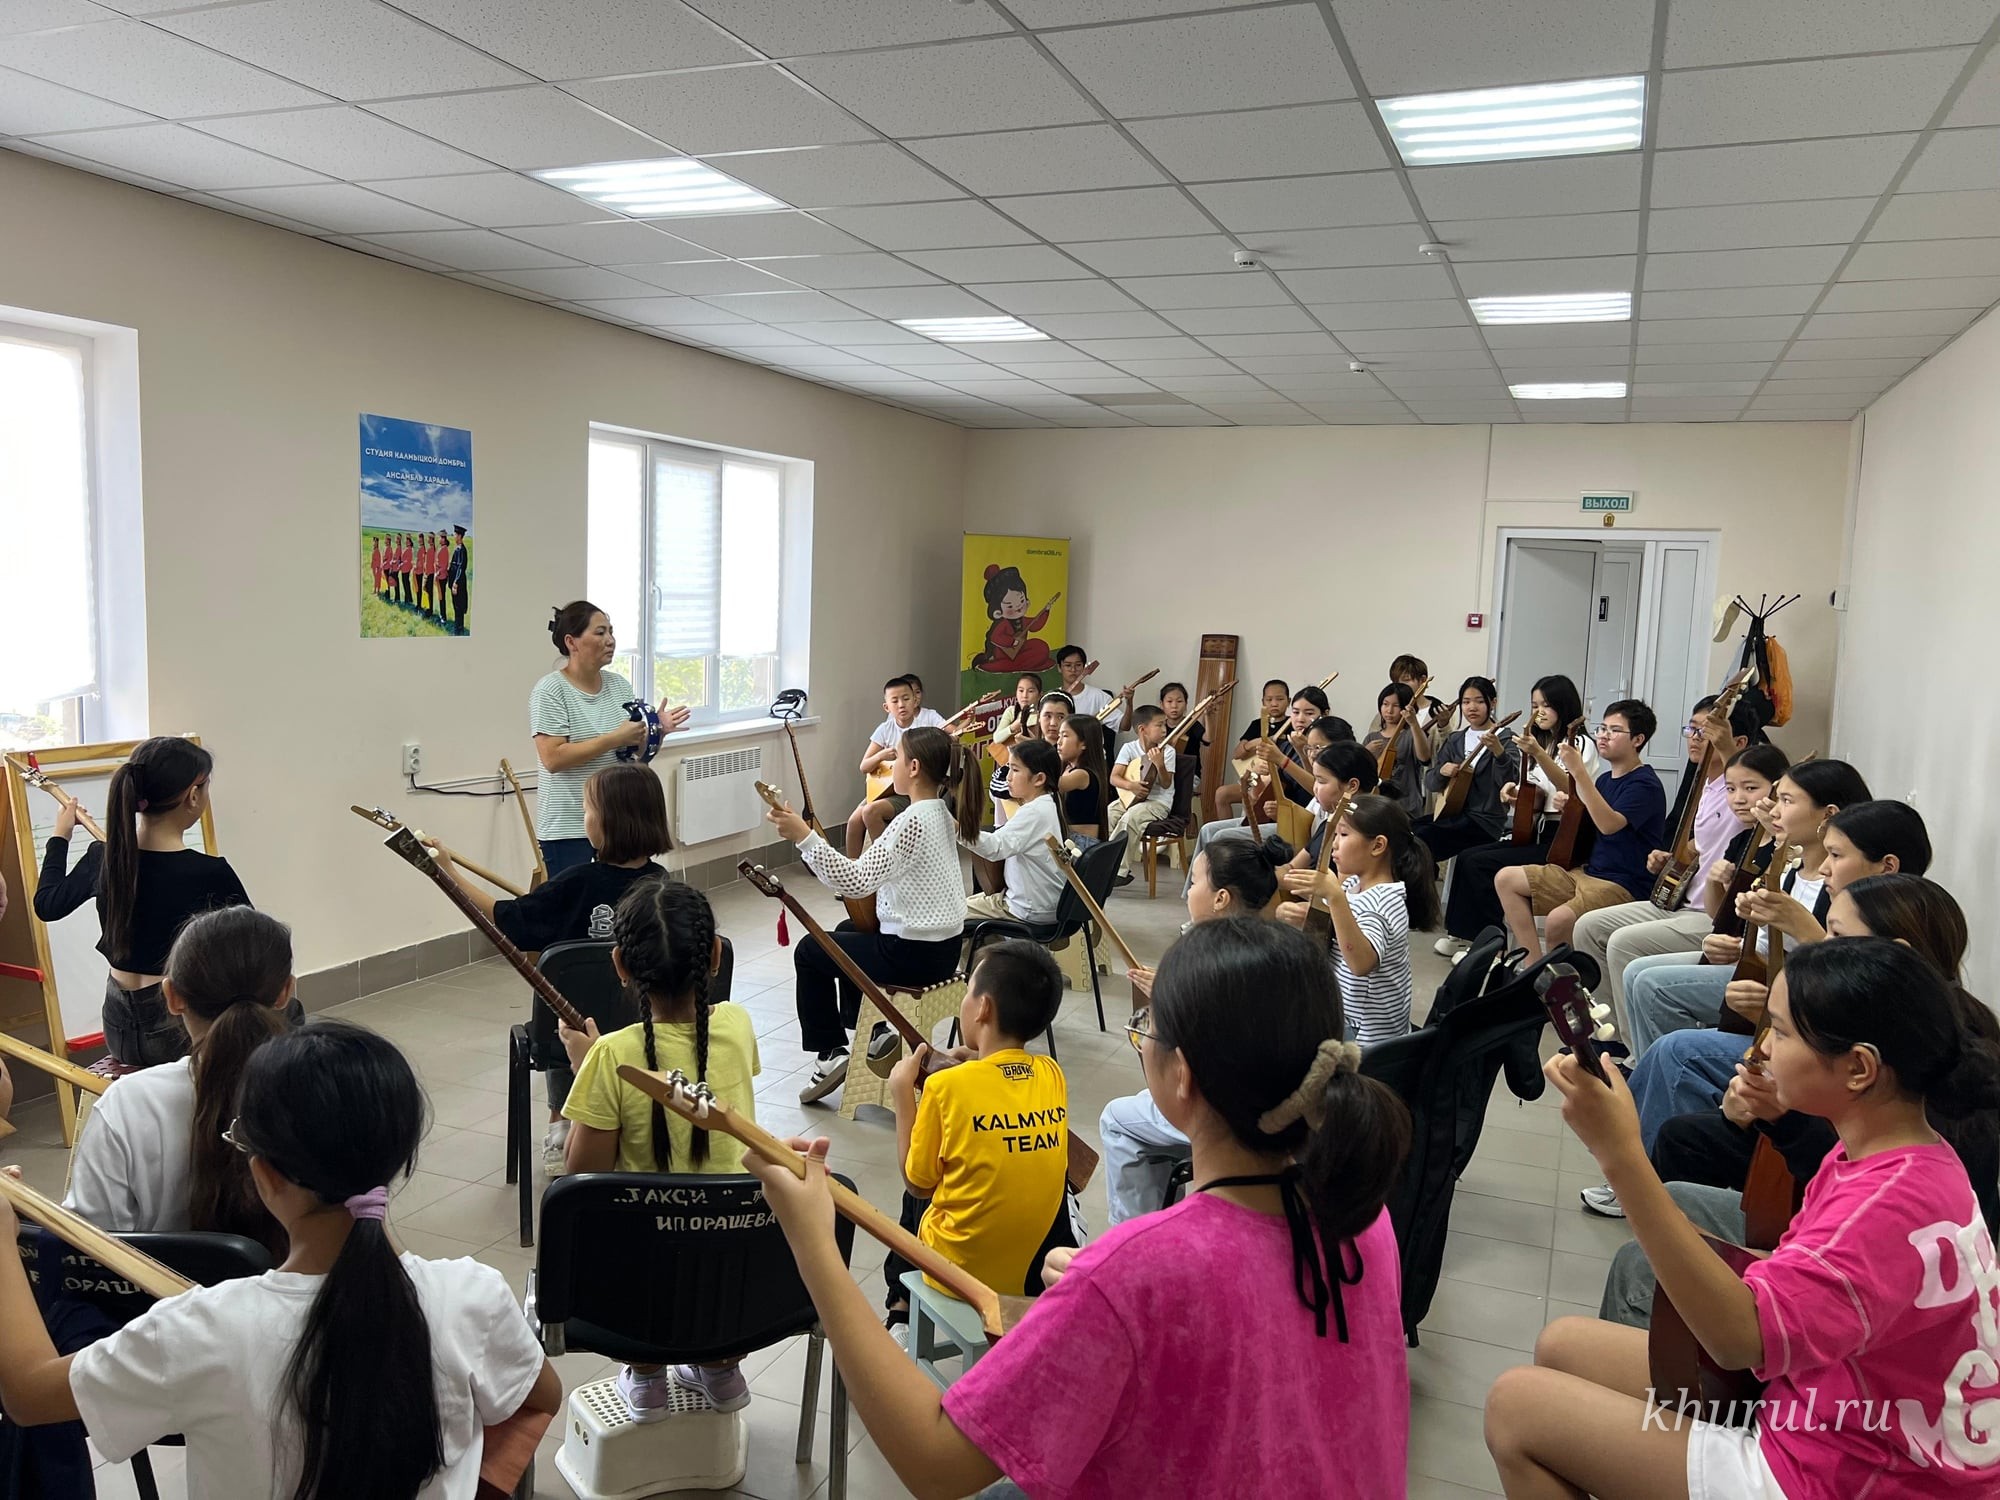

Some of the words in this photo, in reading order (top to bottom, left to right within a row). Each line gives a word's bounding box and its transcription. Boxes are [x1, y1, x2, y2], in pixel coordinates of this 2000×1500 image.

[365, 447, 393, 458] СТУДИЯ
[394, 451, 438, 464] КАЛМЫЦКОЙ
[438, 457, 467, 468] ДОМБРЫ
[385, 471, 423, 482] АНСАМБЛЬ
[424, 475, 450, 485] ХАРАДА
[1584, 498, 1628, 509] ВЫХОД
[1002, 1131, 1060, 1153] TEAM
